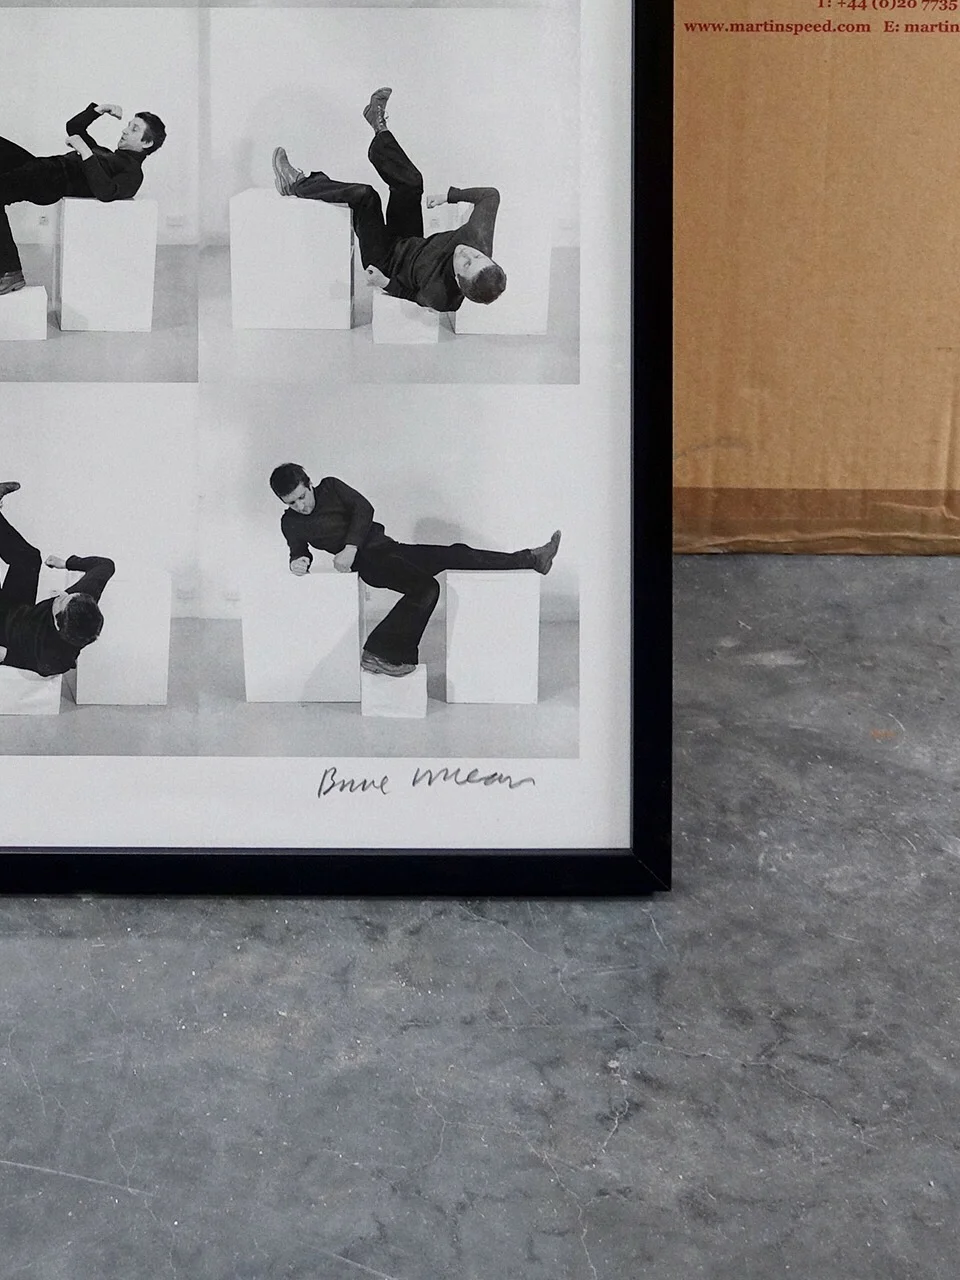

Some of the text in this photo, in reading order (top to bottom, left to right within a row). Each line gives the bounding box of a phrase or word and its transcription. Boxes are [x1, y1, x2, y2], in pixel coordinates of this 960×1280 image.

[921, 0, 958, 11] 7735
[684, 20, 960, 35] www.martinspeed.com E: martin
